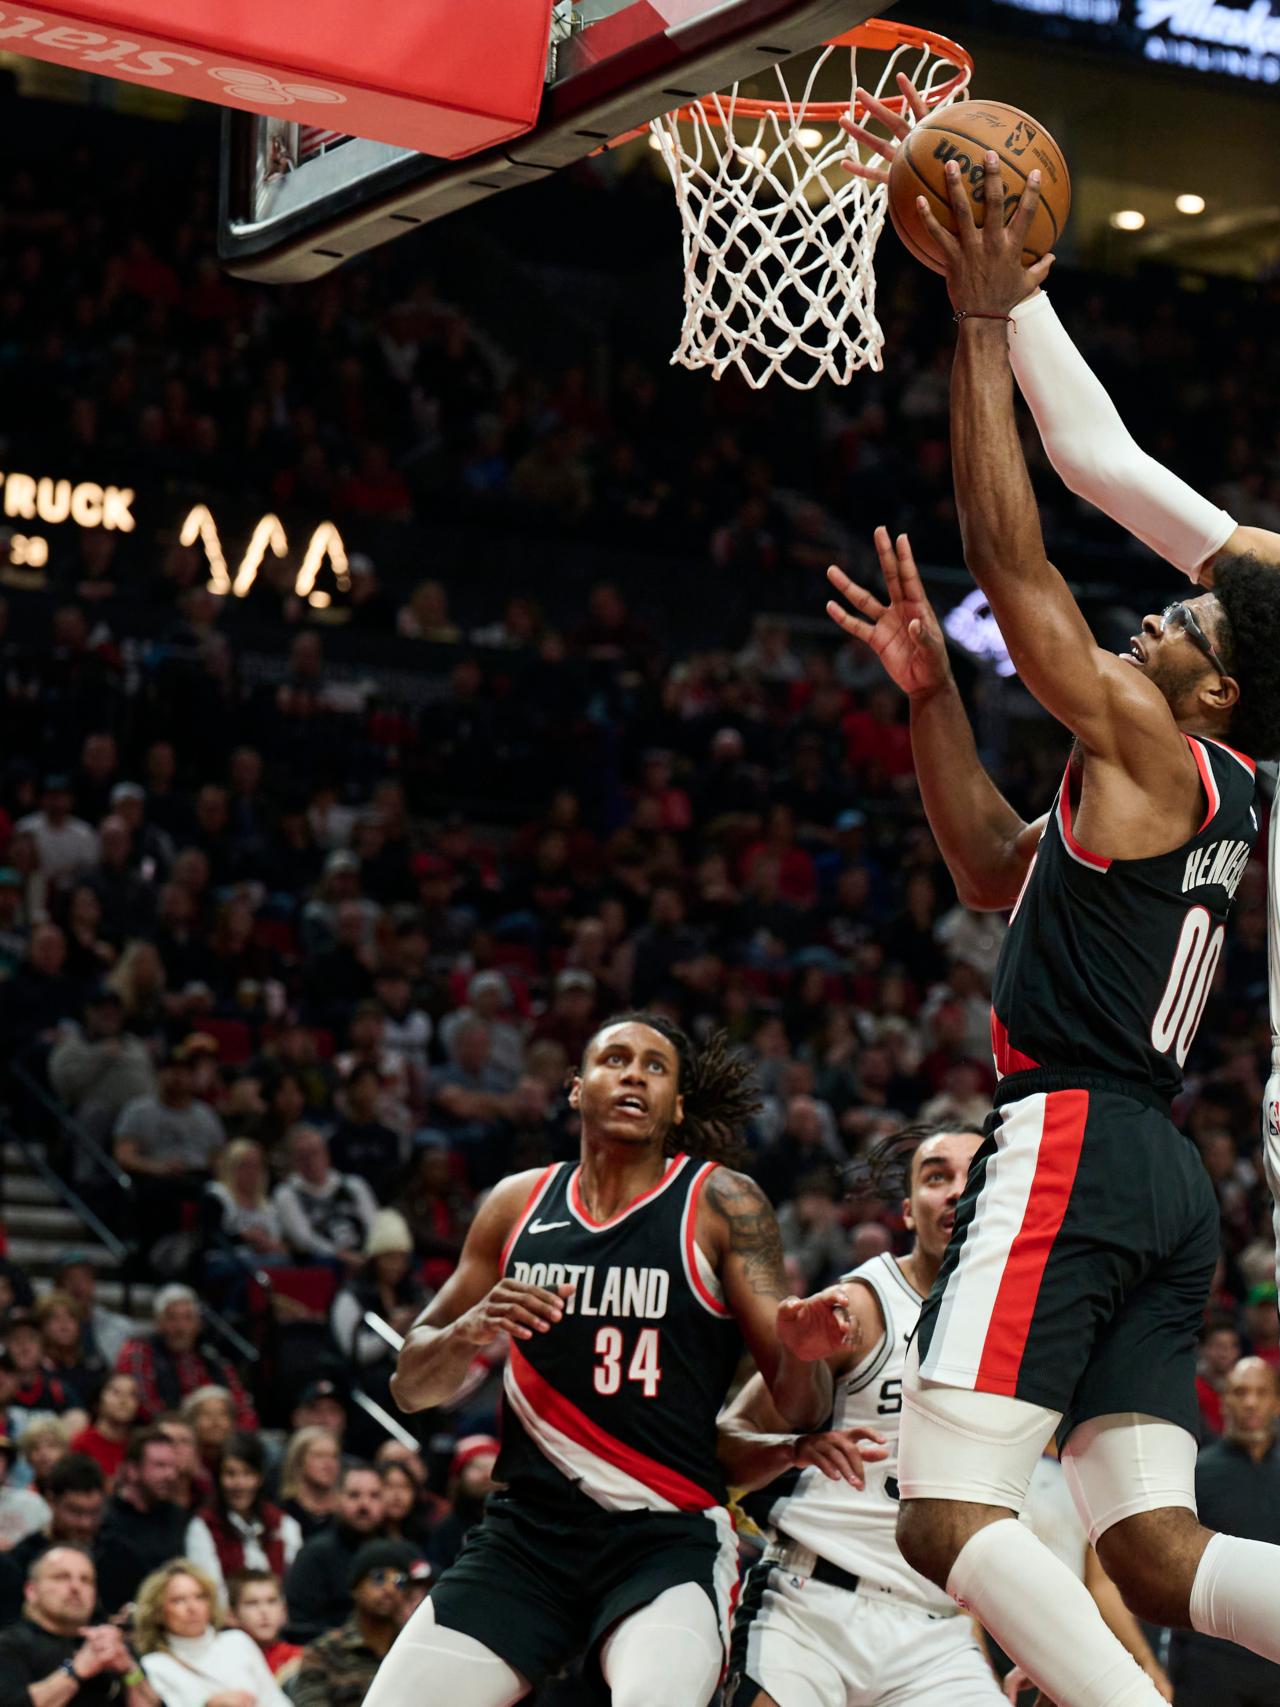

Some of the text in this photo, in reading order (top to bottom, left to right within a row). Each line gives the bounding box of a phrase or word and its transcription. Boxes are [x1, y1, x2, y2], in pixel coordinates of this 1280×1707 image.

[0, 11, 203, 76] Stat
[0, 472, 136, 532] RUCK
[1151, 905, 1225, 1069] 00
[593, 1326, 662, 1397] 34
